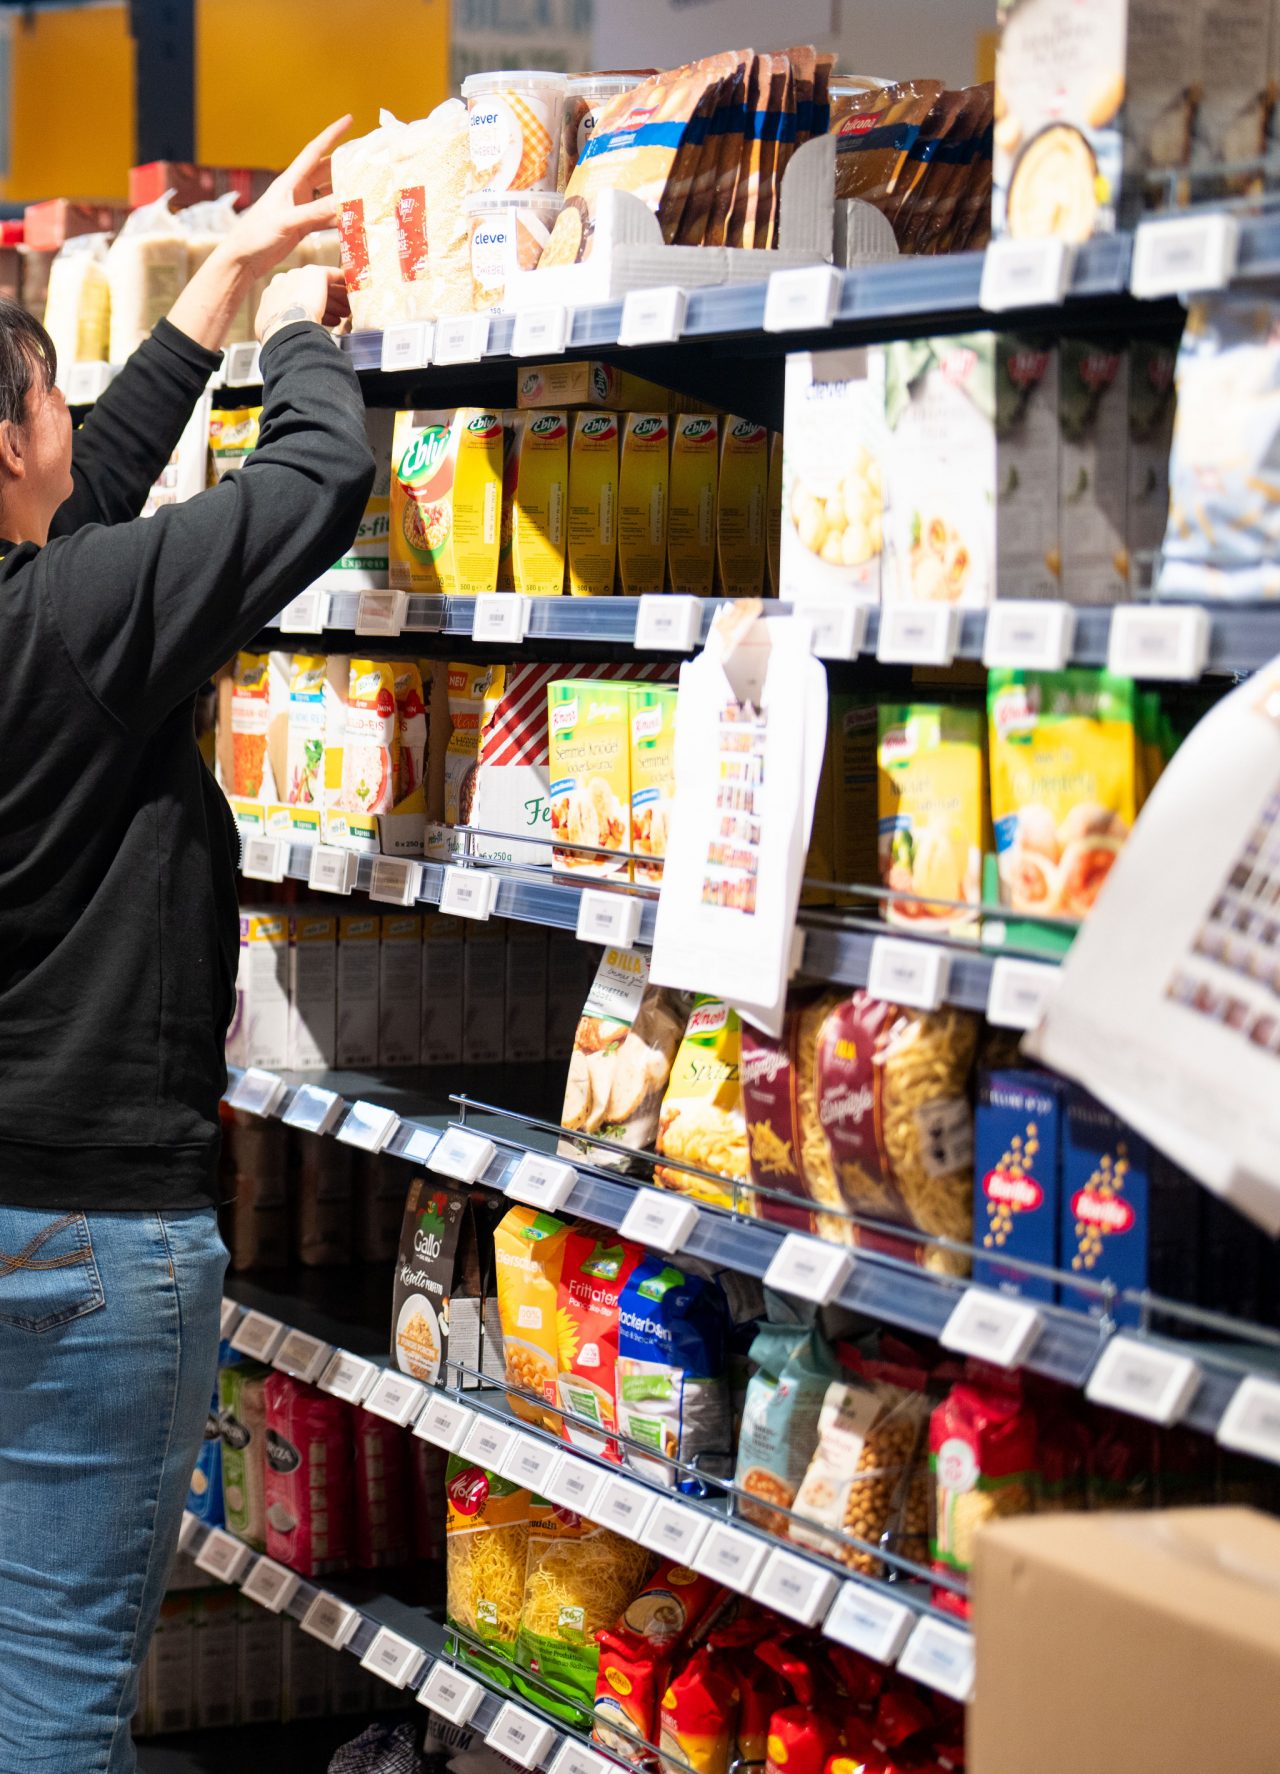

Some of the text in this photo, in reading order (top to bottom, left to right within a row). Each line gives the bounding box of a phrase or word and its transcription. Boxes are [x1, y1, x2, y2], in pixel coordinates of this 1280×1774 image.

[469, 416, 495, 431] Ebly
[533, 416, 561, 432] Ebly
[584, 417, 611, 433] Ebly
[635, 418, 661, 434] Ebly
[682, 419, 710, 435] Ebly
[733, 420, 760, 436] Ebly
[402, 432, 451, 477] Ebly
[341, 558, 384, 570] Express
[460, 583, 470, 591] 500
[449, 676, 465, 687] NEU
[524, 796, 552, 825] Fe
[354, 828, 370, 837] Express
[407, 840, 418, 848] 250
[494, 852, 506, 861] 250
[607, 950, 642, 974] BILLA
[593, 982, 630, 998] ERVIETTEN
[690, 1009, 726, 1030] Knorr
[683, 1058, 740, 1088] Spätz
[414, 1229, 442, 1258] Gallo
[400, 1263, 444, 1296] Risotto PERFETTO
[451, 1474, 485, 1508] Wolf
[431, 1720, 475, 1751] EMIUM
